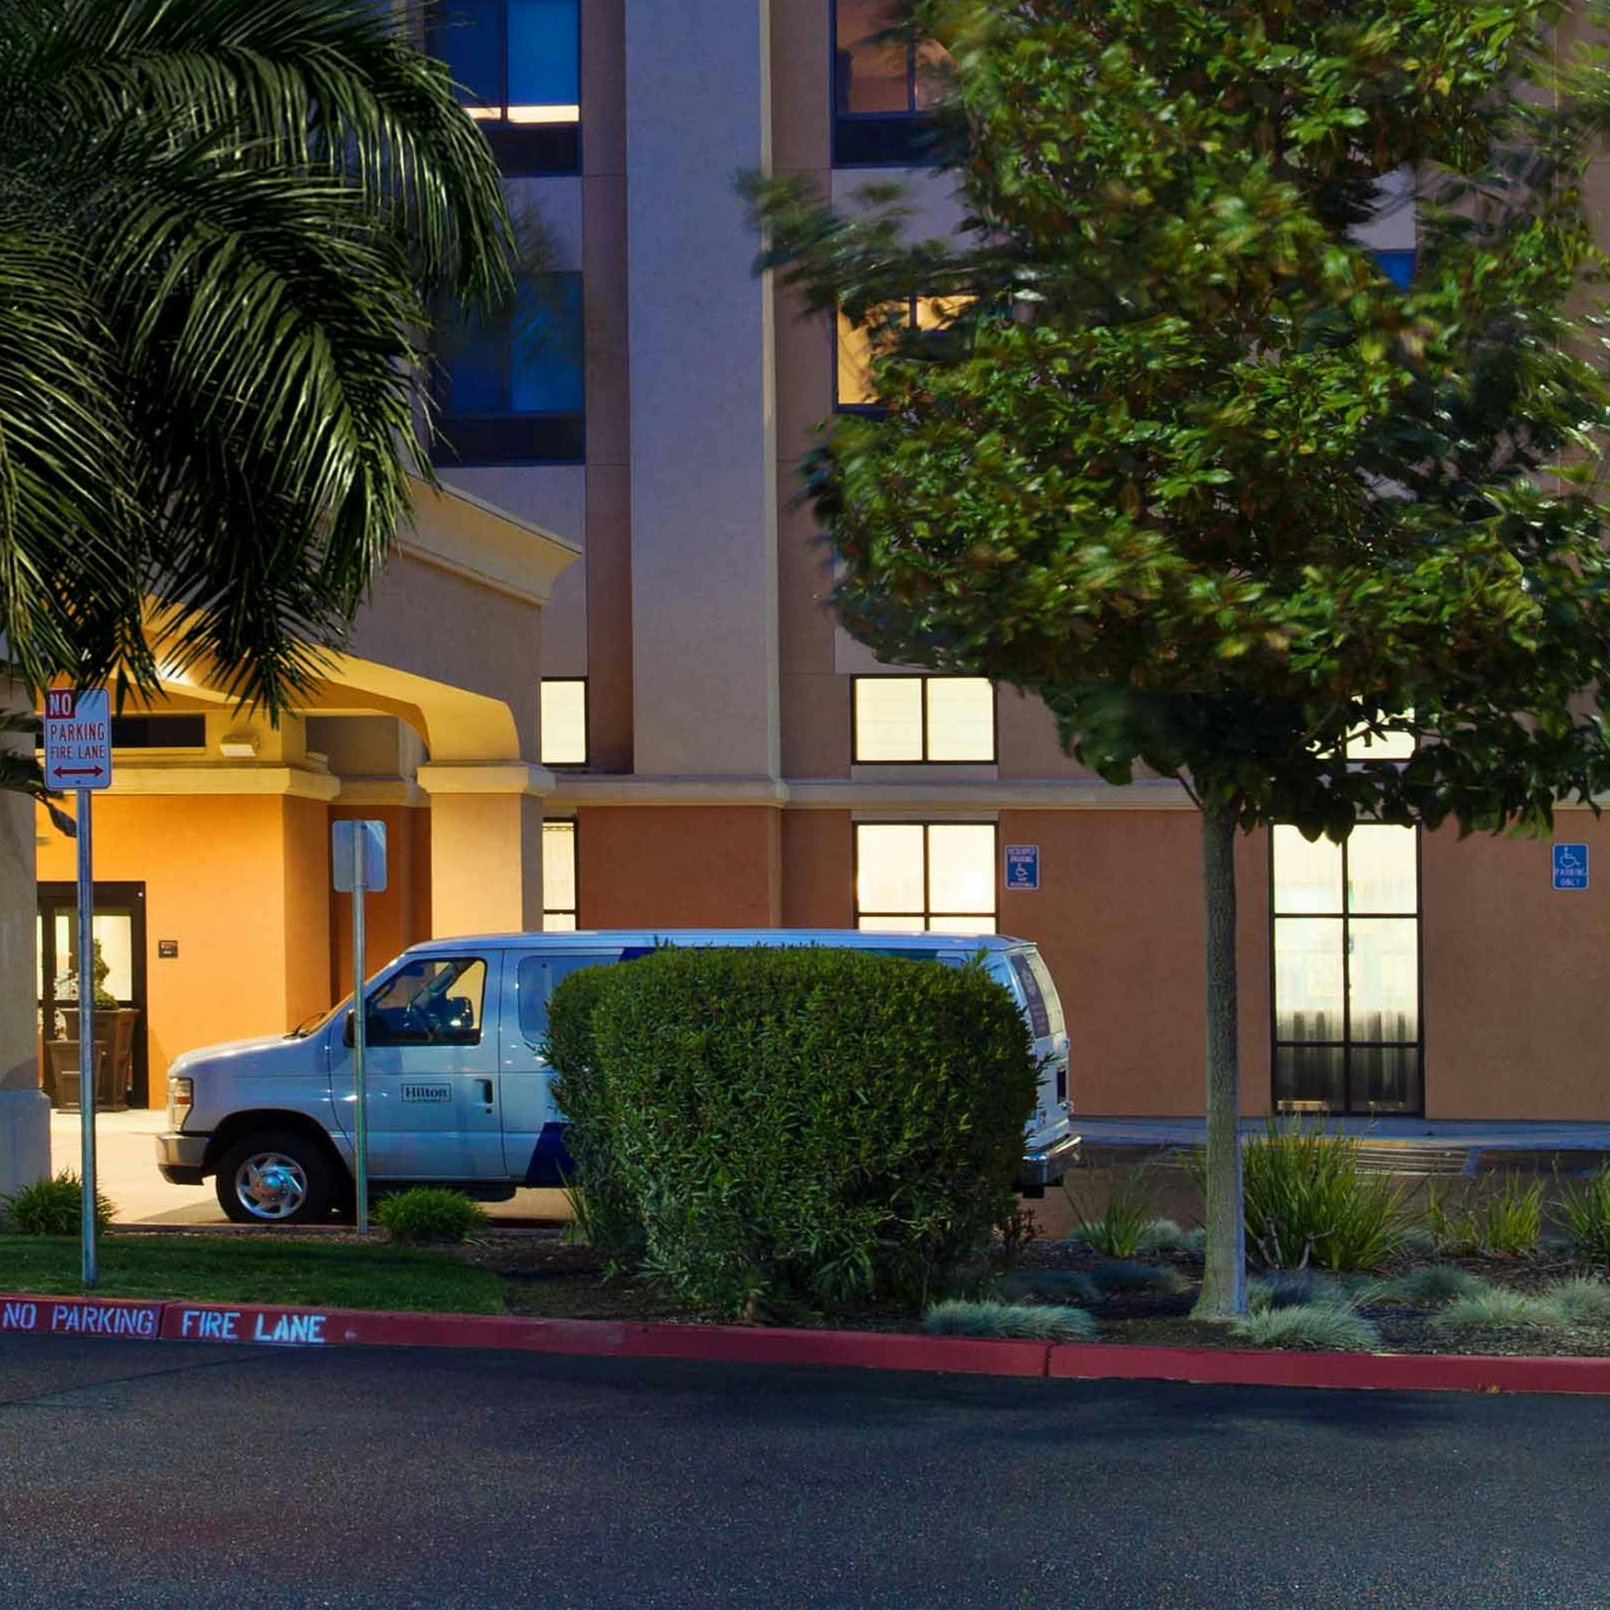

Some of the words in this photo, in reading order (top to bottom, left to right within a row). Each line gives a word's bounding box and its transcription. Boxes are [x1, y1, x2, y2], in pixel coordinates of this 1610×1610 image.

[49, 692, 72, 716] NO
[50, 722, 105, 743] PARKING
[50, 745, 73, 759] FIRE
[78, 744, 105, 759] LANE
[405, 1086, 448, 1098] Hilton
[2, 1302, 37, 1330] NO
[51, 1304, 155, 1336] PARKING
[181, 1309, 241, 1340] FIRE
[254, 1313, 328, 1343] LANE
